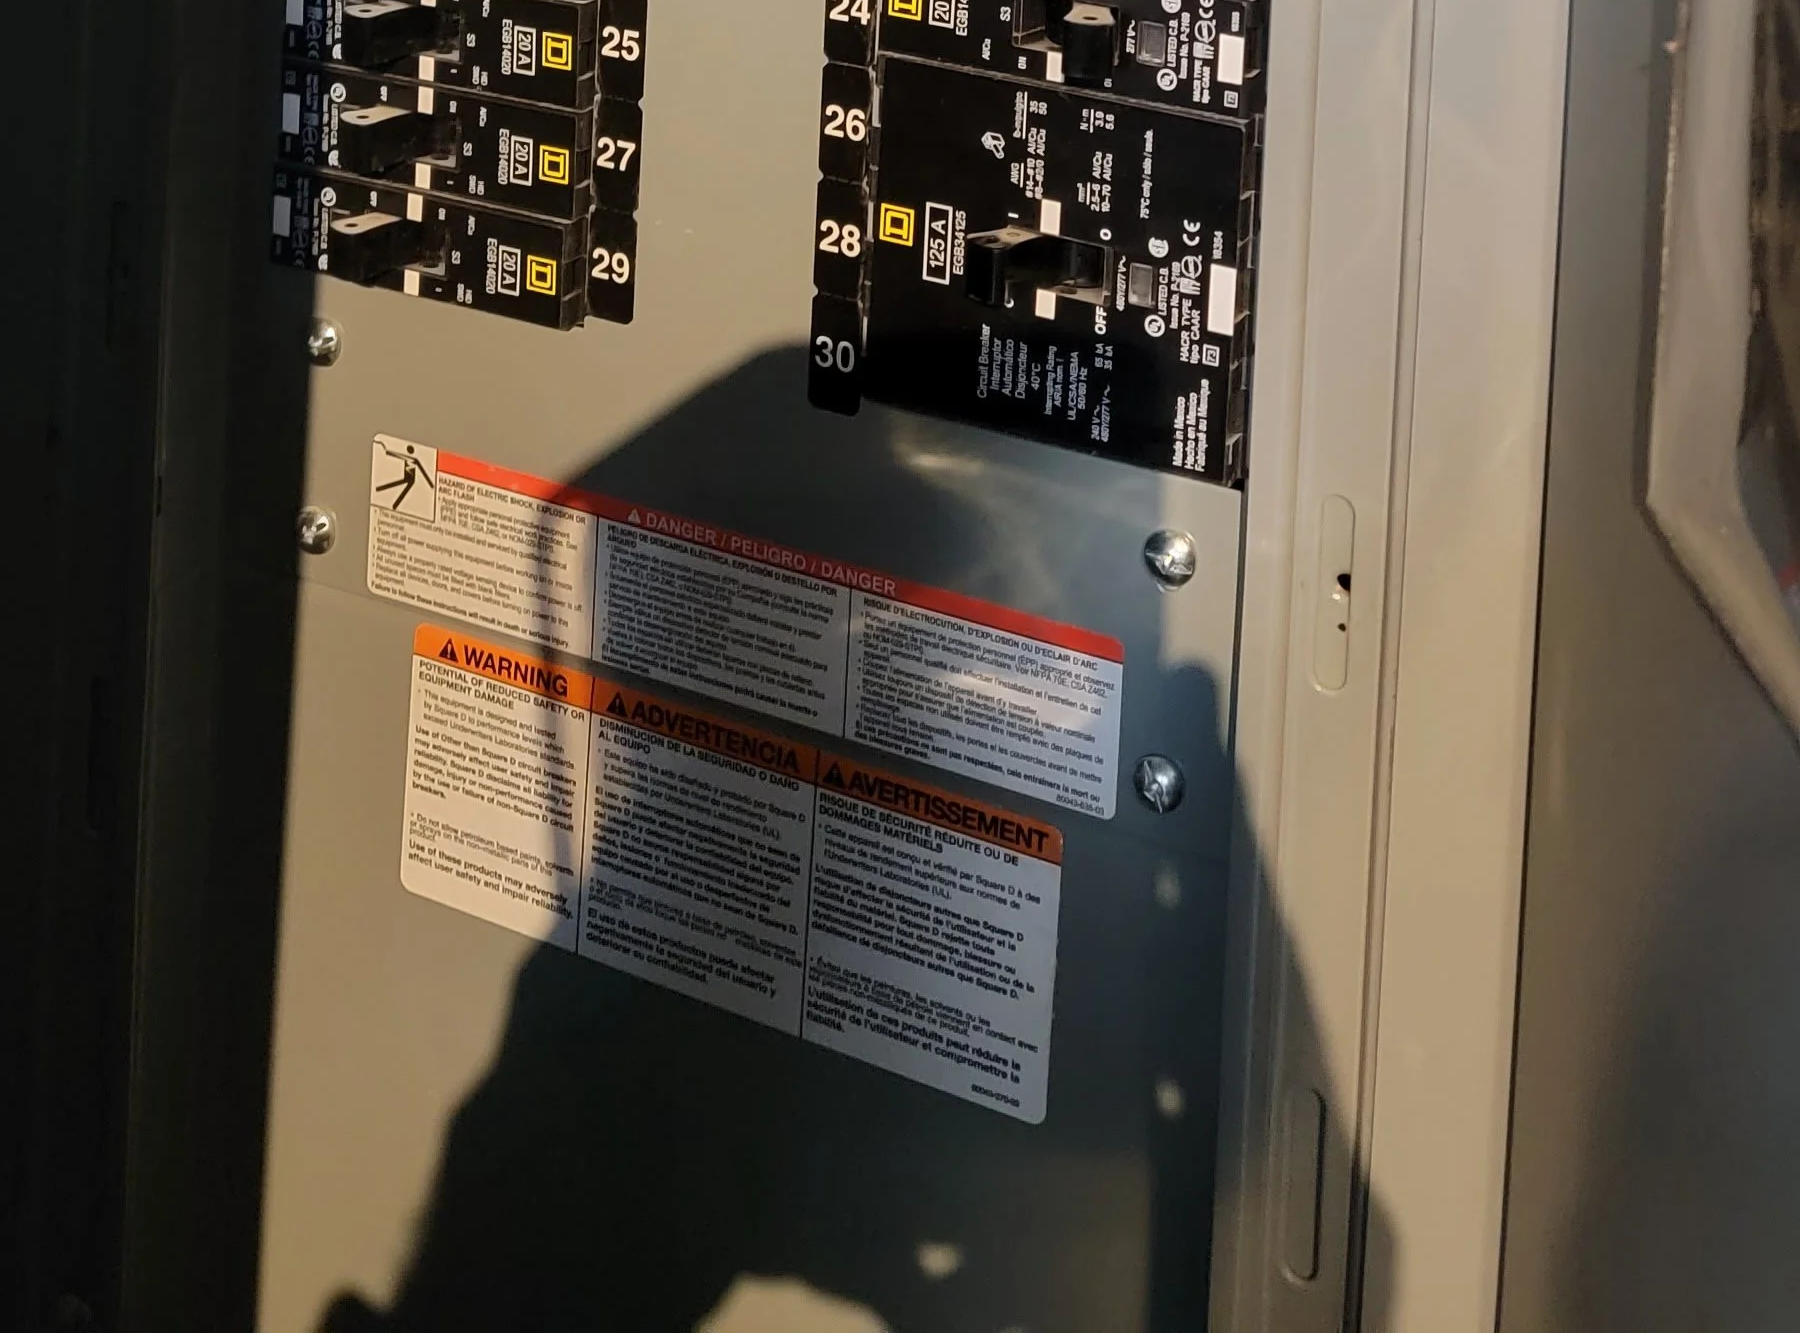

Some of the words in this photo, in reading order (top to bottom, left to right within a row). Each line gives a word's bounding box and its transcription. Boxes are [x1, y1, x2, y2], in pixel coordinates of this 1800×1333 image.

[934, 0, 950, 22] 20
[602, 26, 639, 61] 25
[825, 105, 865, 141] 26
[597, 137, 635, 171] 27
[820, 220, 860, 257] 28
[930, 219, 947, 235] A
[953, 210, 966, 275] EGB34125
[592, 248, 629, 283] 29
[928, 237, 945, 268] 125
[1095, 306, 1107, 335] OFF
[816, 336, 854, 372] 30
[646, 512, 717, 547] DANGER
[730, 536, 807, 569] PELIGRO
[821, 561, 897, 597] DANGER
[462, 644, 568, 698] WARNING
[419, 671, 471, 696] EQUIPMENT
[474, 689, 514, 710] DAMAGE
[419, 660, 468, 684] POTENTIAL
[471, 677, 484, 688] OF
[486, 681, 531, 703] REDUCED
[533, 694, 569, 716] SAFETY
[571, 709, 585, 722] OR
[631, 699, 799, 773] ADVERTENCIA
[820, 792, 859, 813] RISQUE
[861, 805, 876, 819] DE
[984, 846, 1001, 860] OU
[1003, 853, 1019, 867] DE
[848, 769, 1050, 854] AVERTISSEMENT
